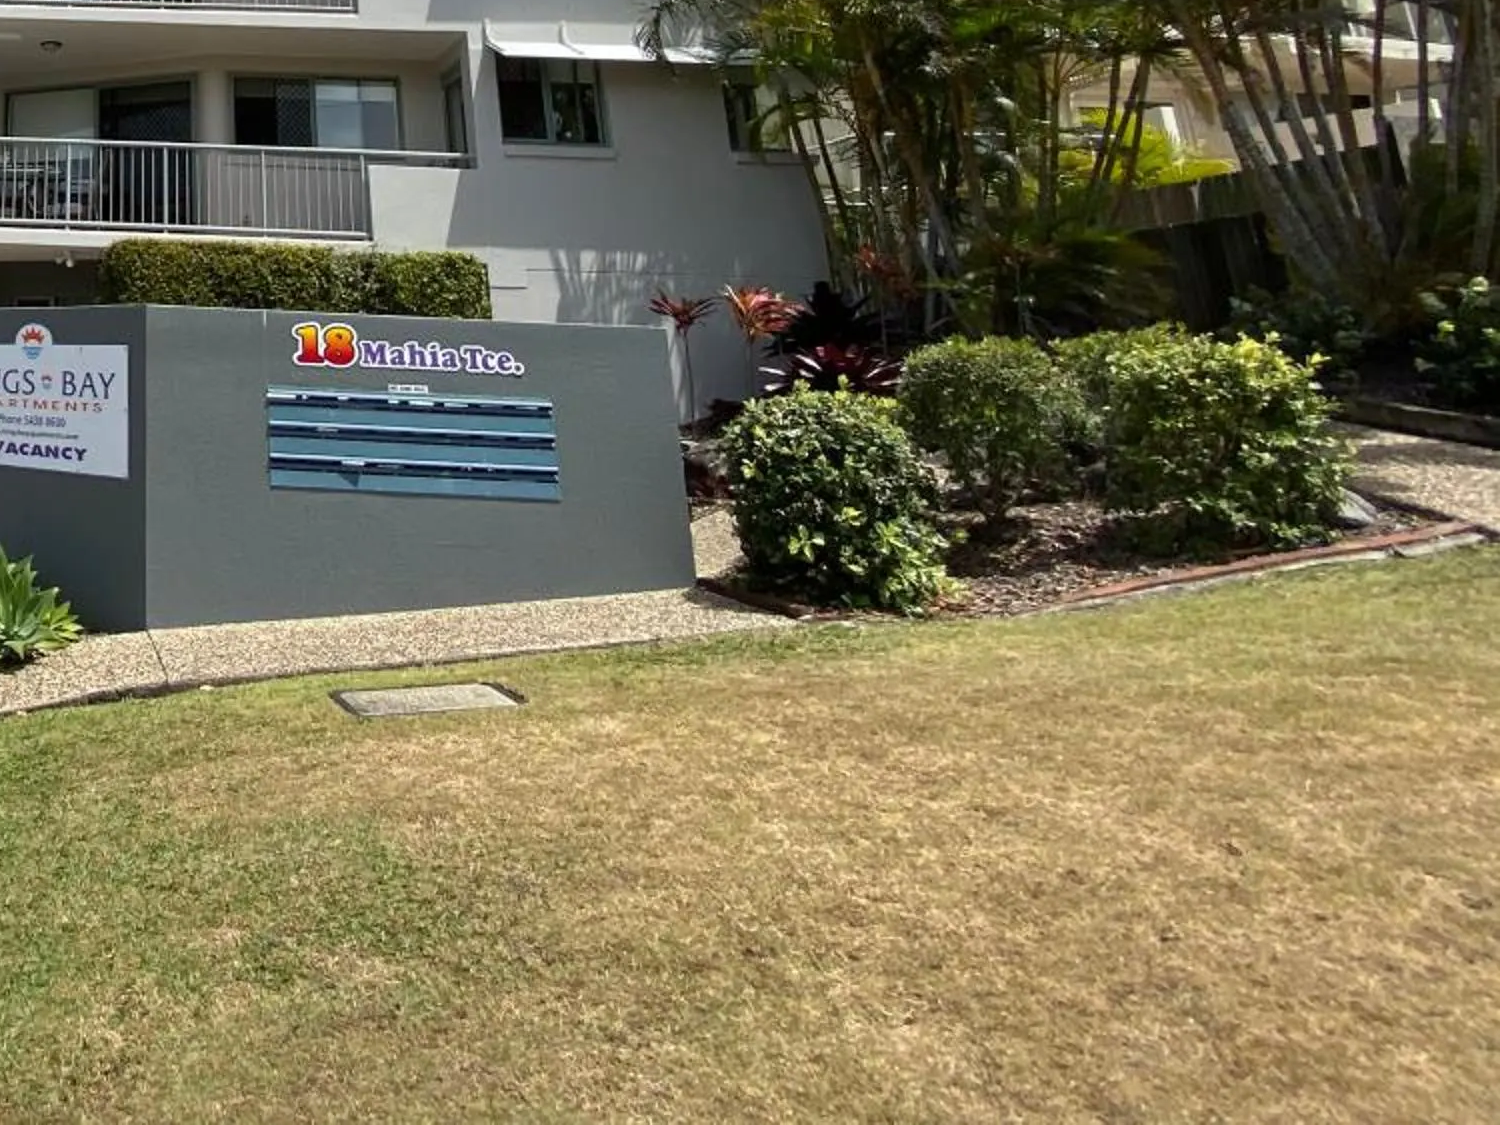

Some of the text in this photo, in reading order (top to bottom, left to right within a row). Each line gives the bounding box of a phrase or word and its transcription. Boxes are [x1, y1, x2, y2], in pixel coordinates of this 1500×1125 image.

[294, 322, 524, 374] 18 Mahia Tce.
[62, 370, 116, 399] BAY
